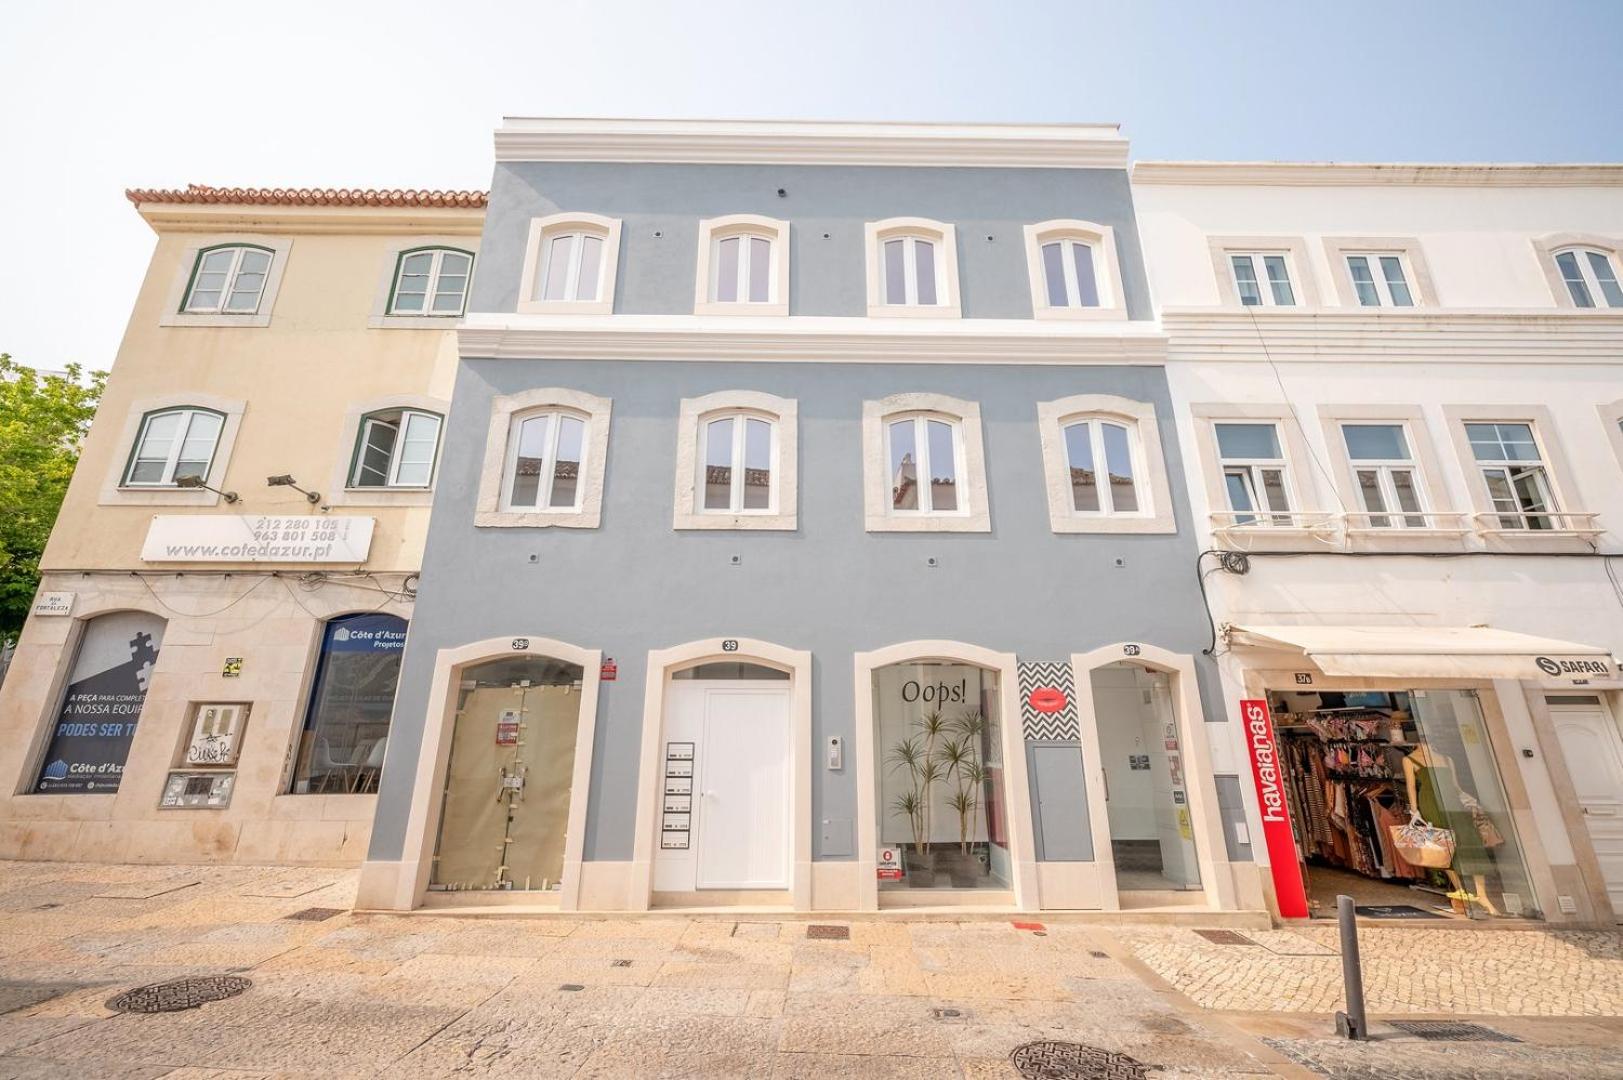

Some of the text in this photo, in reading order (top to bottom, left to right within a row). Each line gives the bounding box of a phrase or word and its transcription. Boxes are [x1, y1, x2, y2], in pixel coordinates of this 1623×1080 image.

[256, 519, 281, 530] 212
[285, 519, 310, 530] 280
[315, 519, 339, 530] 105
[254, 531, 335, 542] 963 801 508
[166, 542, 333, 560] www.cotedazur.pt
[350, 630, 373, 640] Côte
[725, 641, 737, 650] 39
[1560, 660, 1609, 673] SAFARI
[77, 694, 98, 702] PEÇA
[902, 678, 966, 711] Oops!
[64, 704, 72, 714] A
[74, 704, 110, 714] NOSSA
[57, 723, 97, 736] PODES
[98, 723, 122, 736] SER
[70, 763, 96, 773] Côte
[1247, 706, 1285, 822] havaianas
